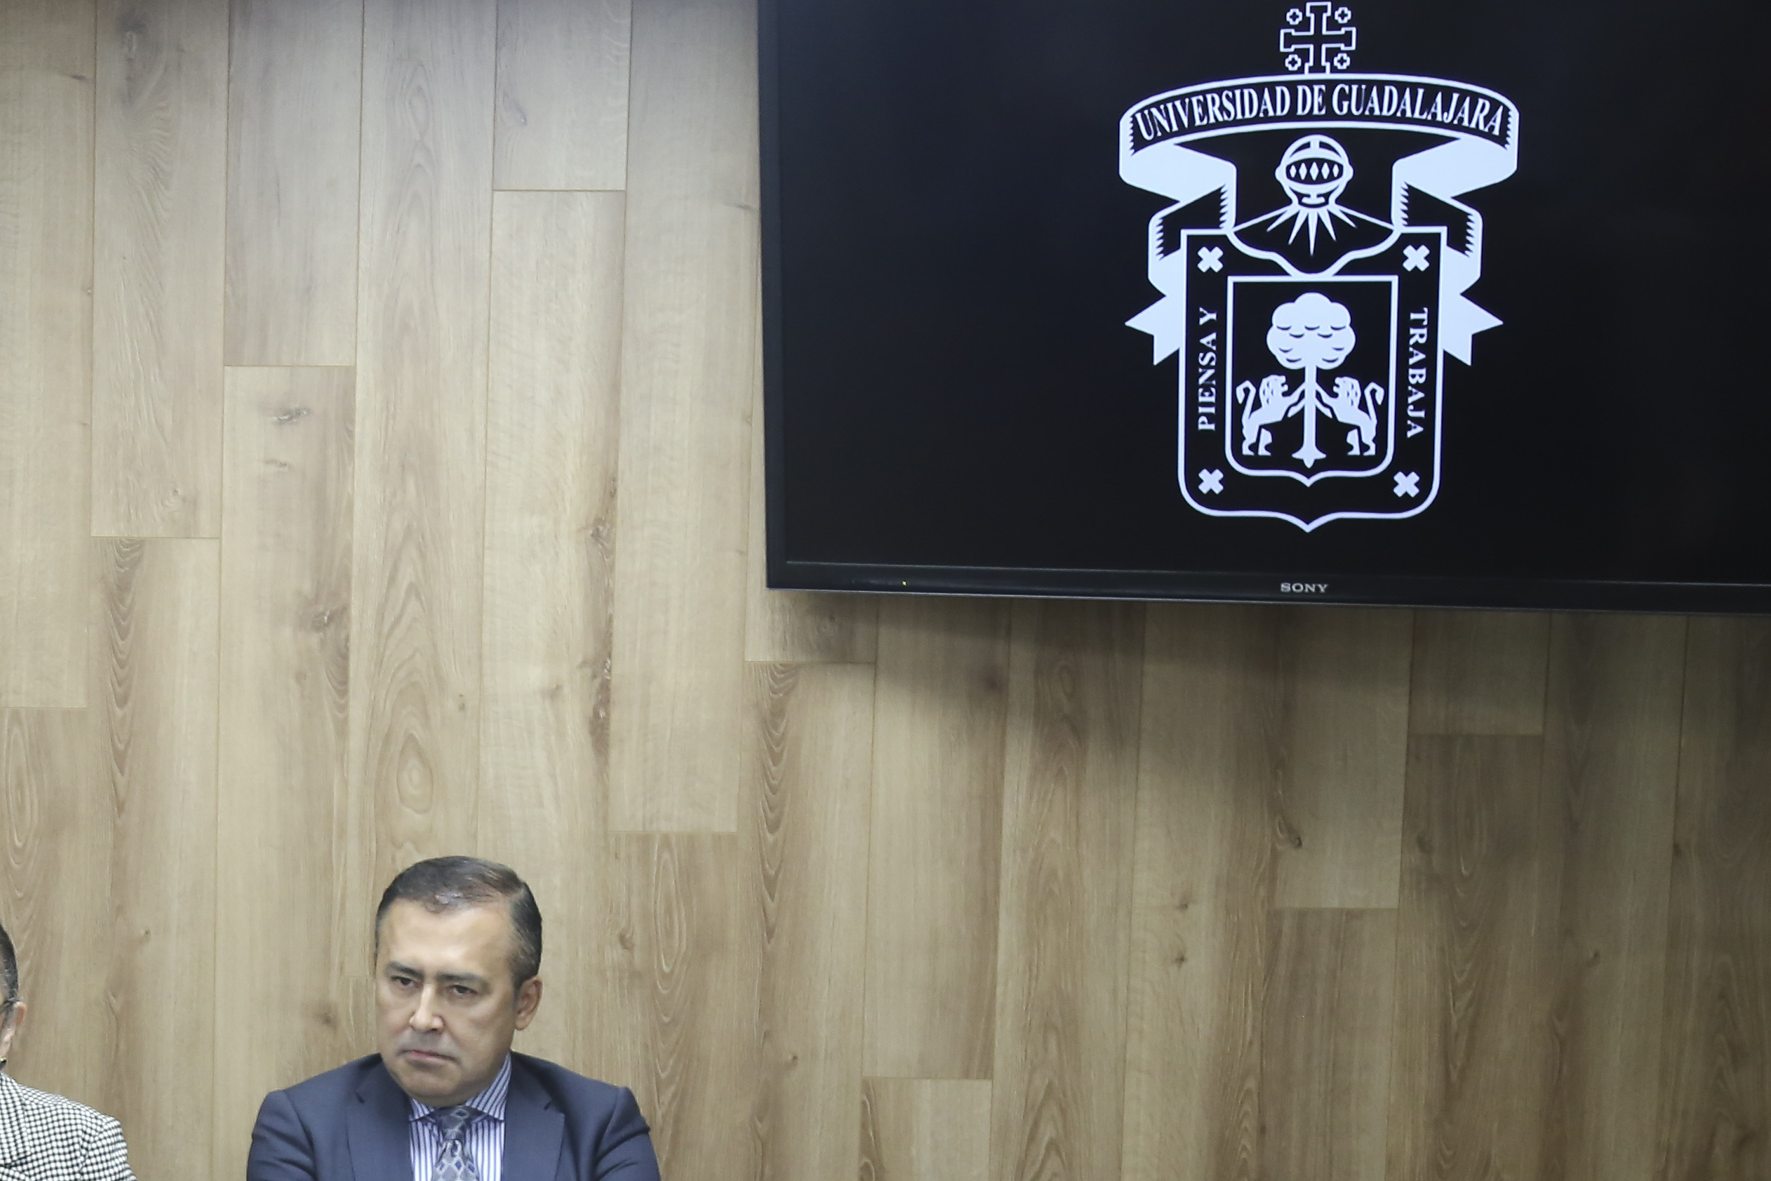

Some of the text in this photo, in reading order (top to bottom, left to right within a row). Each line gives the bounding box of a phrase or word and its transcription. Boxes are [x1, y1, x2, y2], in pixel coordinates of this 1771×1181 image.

[1134, 83, 1505, 141] UNIVERSIDAD DE GUADALAJARA
[1197, 306, 1218, 431] PIENSA Y
[1406, 307, 1429, 439] TRABAJA
[1280, 582, 1328, 593] SONY
